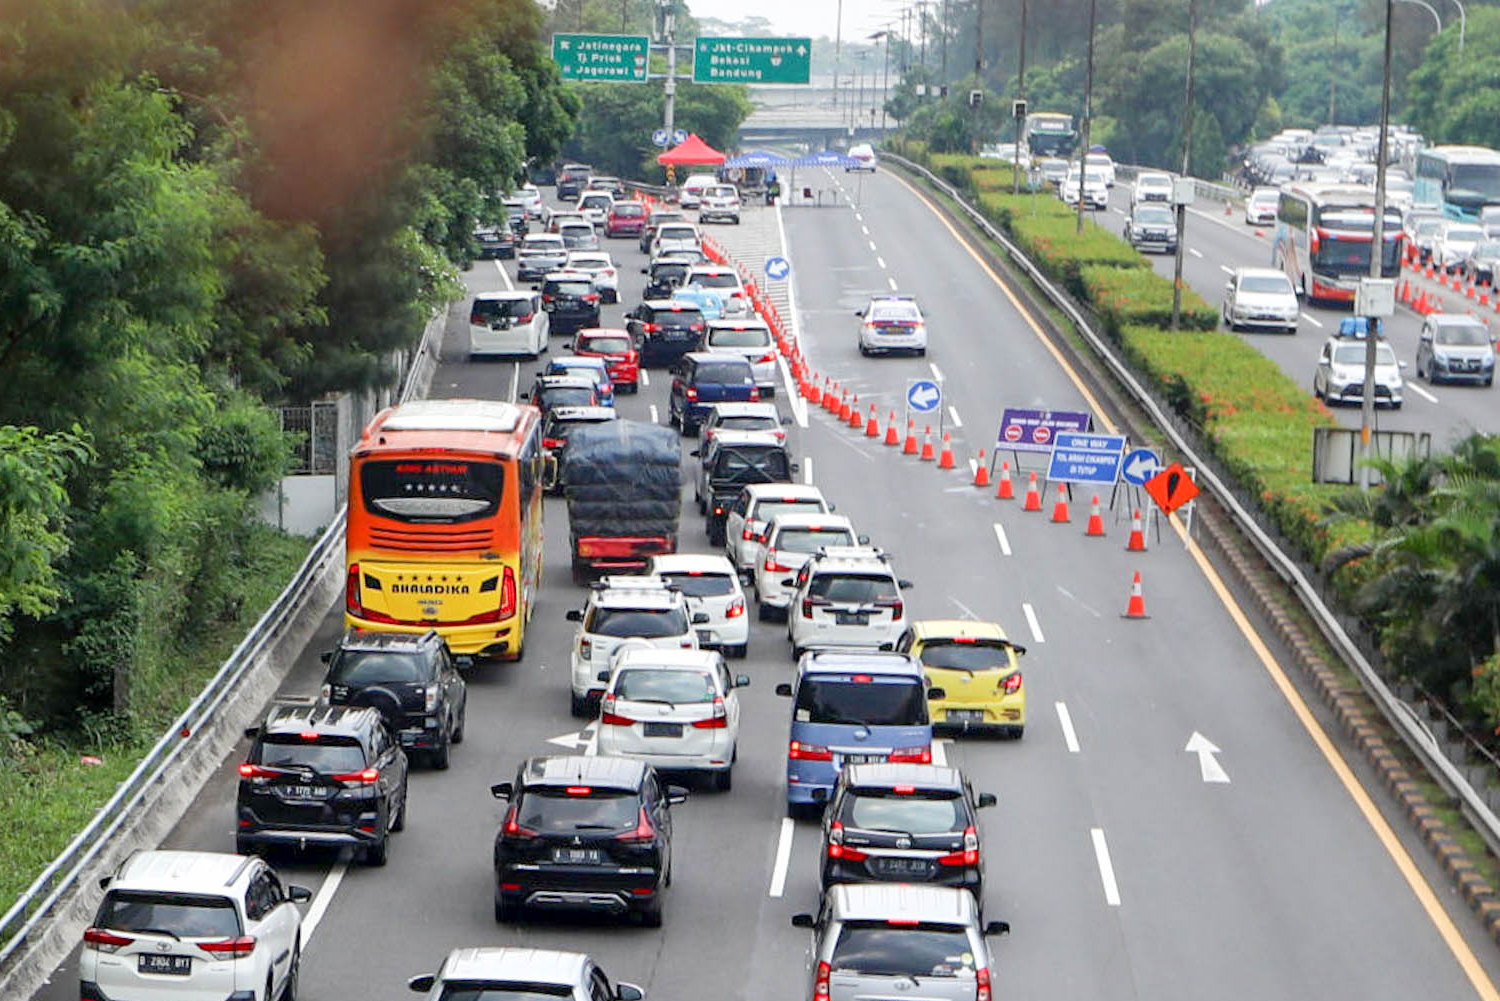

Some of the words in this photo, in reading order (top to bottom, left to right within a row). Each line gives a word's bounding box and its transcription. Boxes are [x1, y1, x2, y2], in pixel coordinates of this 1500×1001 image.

[578, 41, 641, 53] Jatinegara
[712, 43, 793, 55] Jkt-Cikampek
[591, 54, 622, 63] Priok
[710, 56, 750, 65] Bekasi
[576, 66, 629, 76] Jagorawi
[710, 67, 763, 80] Bandung
[1071, 438, 1088, 447] ONE
[1090, 440, 1108, 448] WAY
